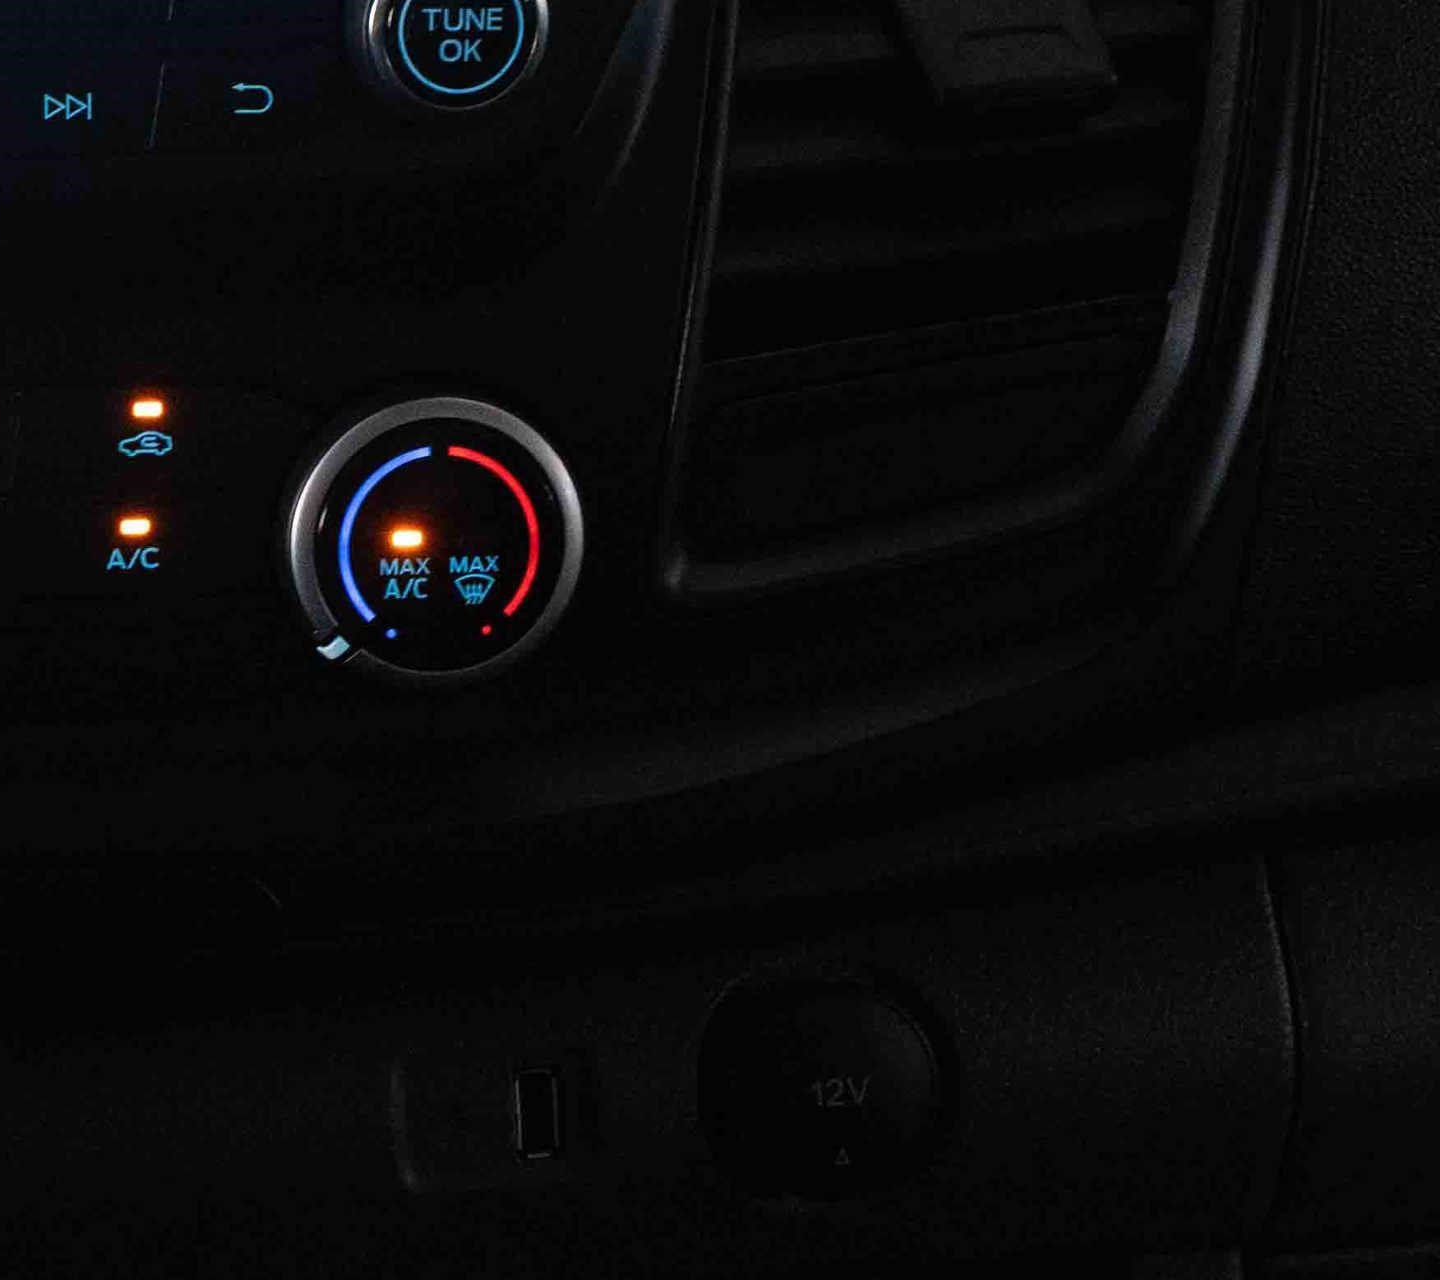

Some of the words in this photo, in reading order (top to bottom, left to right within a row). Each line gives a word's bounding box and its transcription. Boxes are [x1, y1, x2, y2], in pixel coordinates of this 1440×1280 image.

[422, 8, 502, 31] TUNE
[440, 39, 480, 62] OK
[107, 548, 158, 569] A/C
[381, 558, 429, 575] MAX
[450, 556, 497, 572] MAX
[385, 578, 427, 598] A/C
[812, 1077, 869, 1106] 12V
